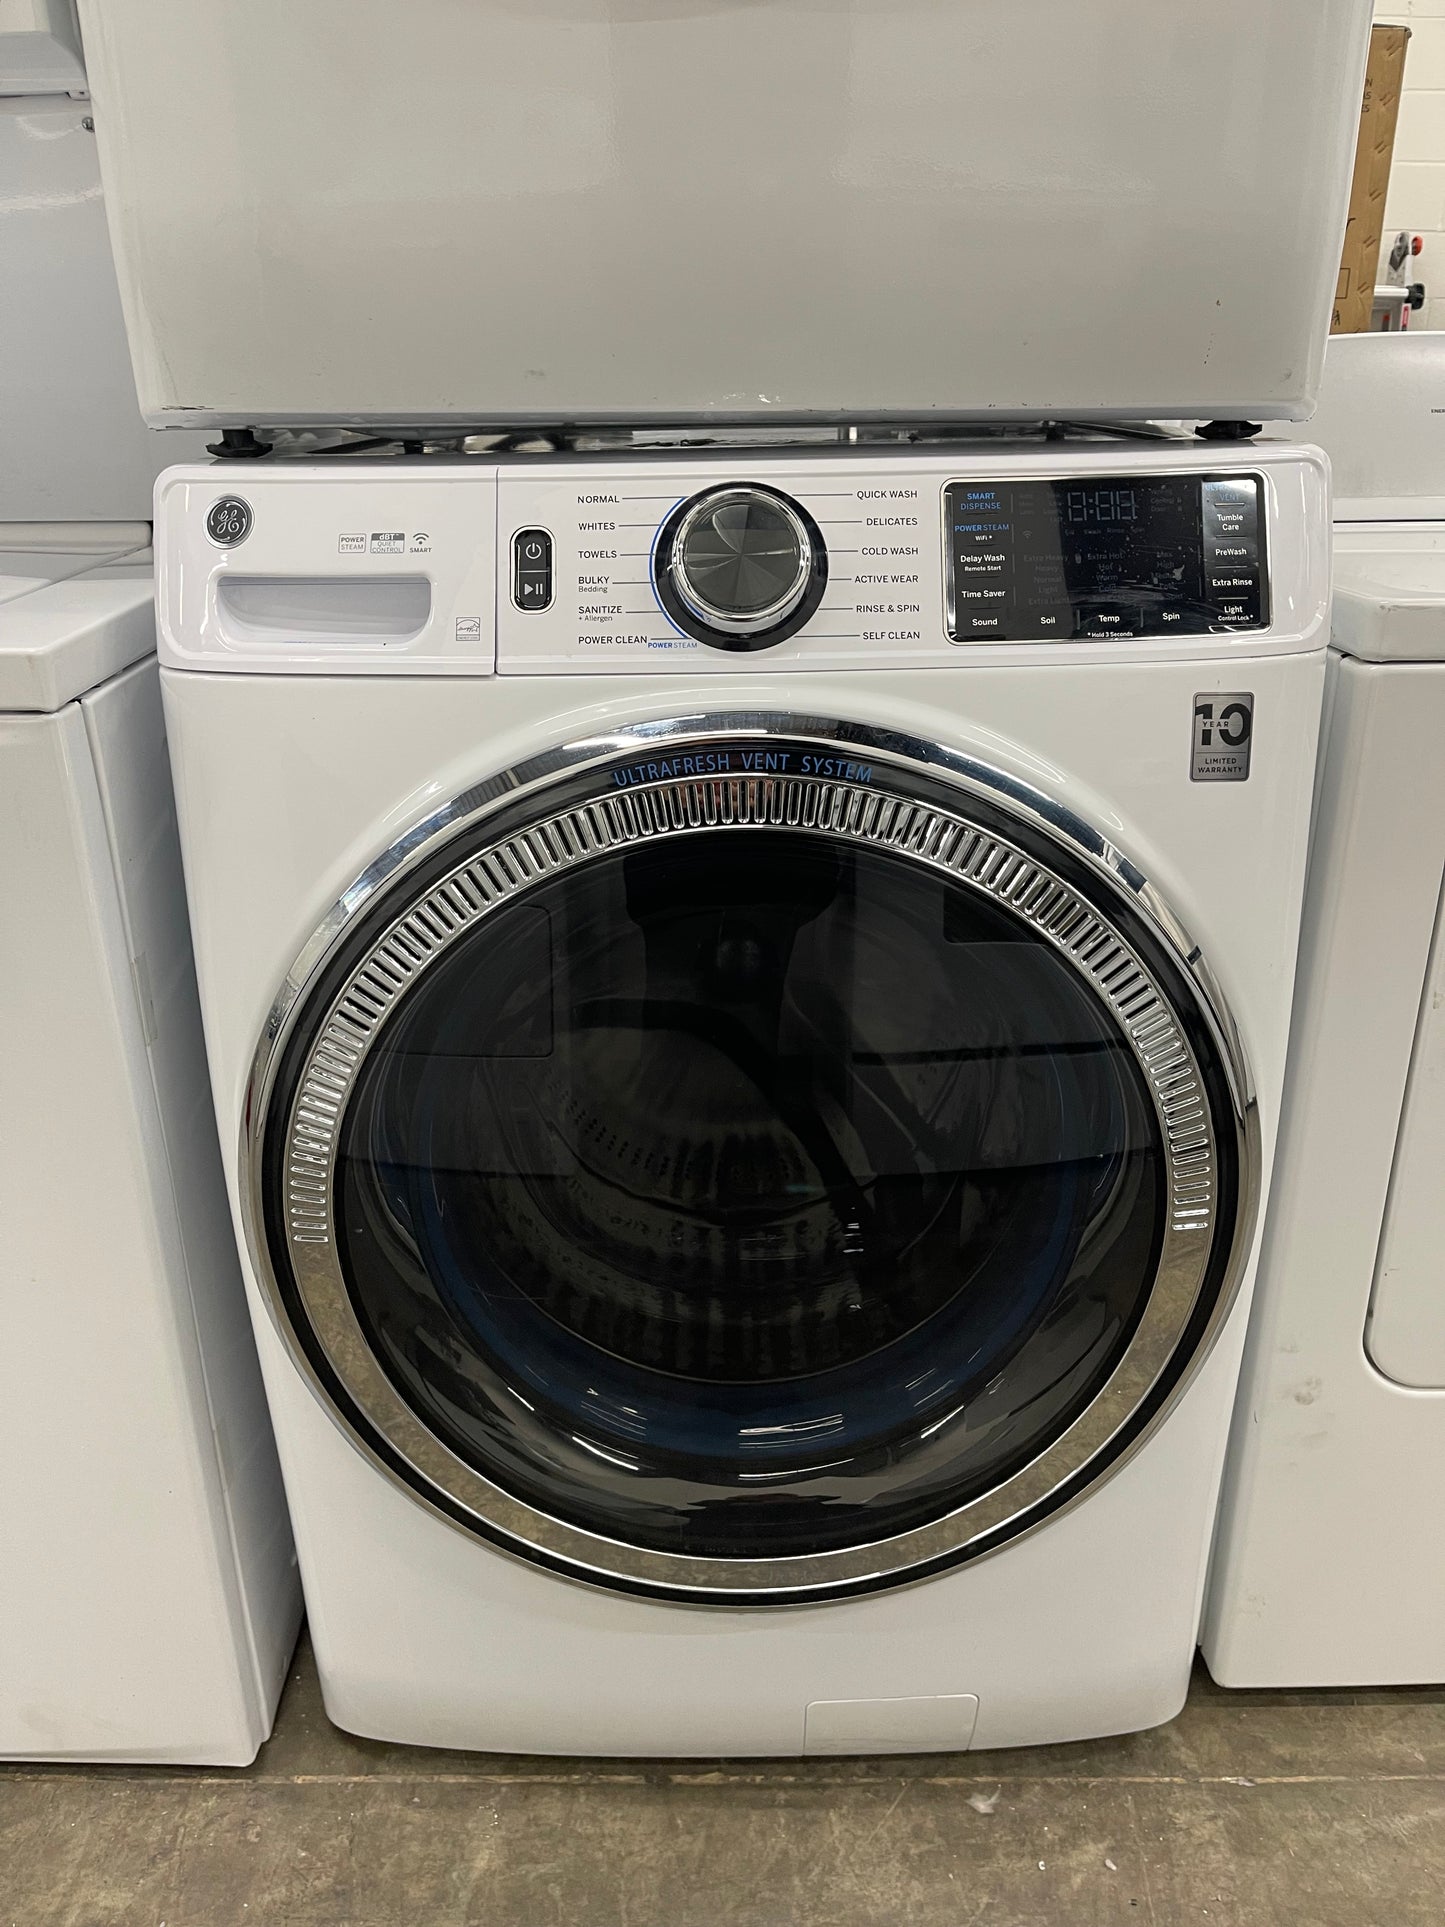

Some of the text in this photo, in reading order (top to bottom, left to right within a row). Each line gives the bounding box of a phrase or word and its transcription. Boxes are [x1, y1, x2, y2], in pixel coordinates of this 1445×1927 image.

[856, 490, 918, 499] QUICK WASH
[967, 492, 996, 500] SMART
[577, 495, 620, 504] NORMAL
[960, 502, 1002, 510] DISPENSE
[1217, 513, 1244, 521] Tumble
[866, 517, 918, 526] DELICATES
[578, 522, 616, 531] WHITES
[1222, 523, 1240, 531] Care
[341, 543, 364, 551] STEAM
[578, 550, 617, 559] TOWELS
[861, 547, 919, 556] COLD WASH
[1215, 548, 1247, 556] PreWash
[960, 554, 1005, 563] Delay Wash
[578, 576, 610, 585] BULKY
[854, 575, 919, 583] ACTIVE WEAR
[1212, 578, 1253, 586] Extra Rinse
[578, 586, 608, 594] Bedding
[961, 590, 1006, 598] Time Saver
[578, 606, 623, 614] SANITIZE
[856, 604, 920, 613] RINSE & SPIN
[1224, 605, 1243, 615] Light
[584, 615, 613, 623] Allergen
[1040, 616, 1056, 624] Soil
[1098, 614, 1121, 623] Temp
[1162, 612, 1180, 620] Spin
[972, 618, 998, 626] Sound
[862, 631, 921, 640] SELF CLEAN
[1110, 630, 1133, 638] Seconds
[578, 635, 648, 645] POWER CLEAN
[1195, 702, 1252, 747] 10
[1204, 757, 1237, 765] LIMITED
[613, 751, 873, 787] ULTRAFRESH VENT SYSTEM
[1197, 766, 1242, 774] WARRANTY
